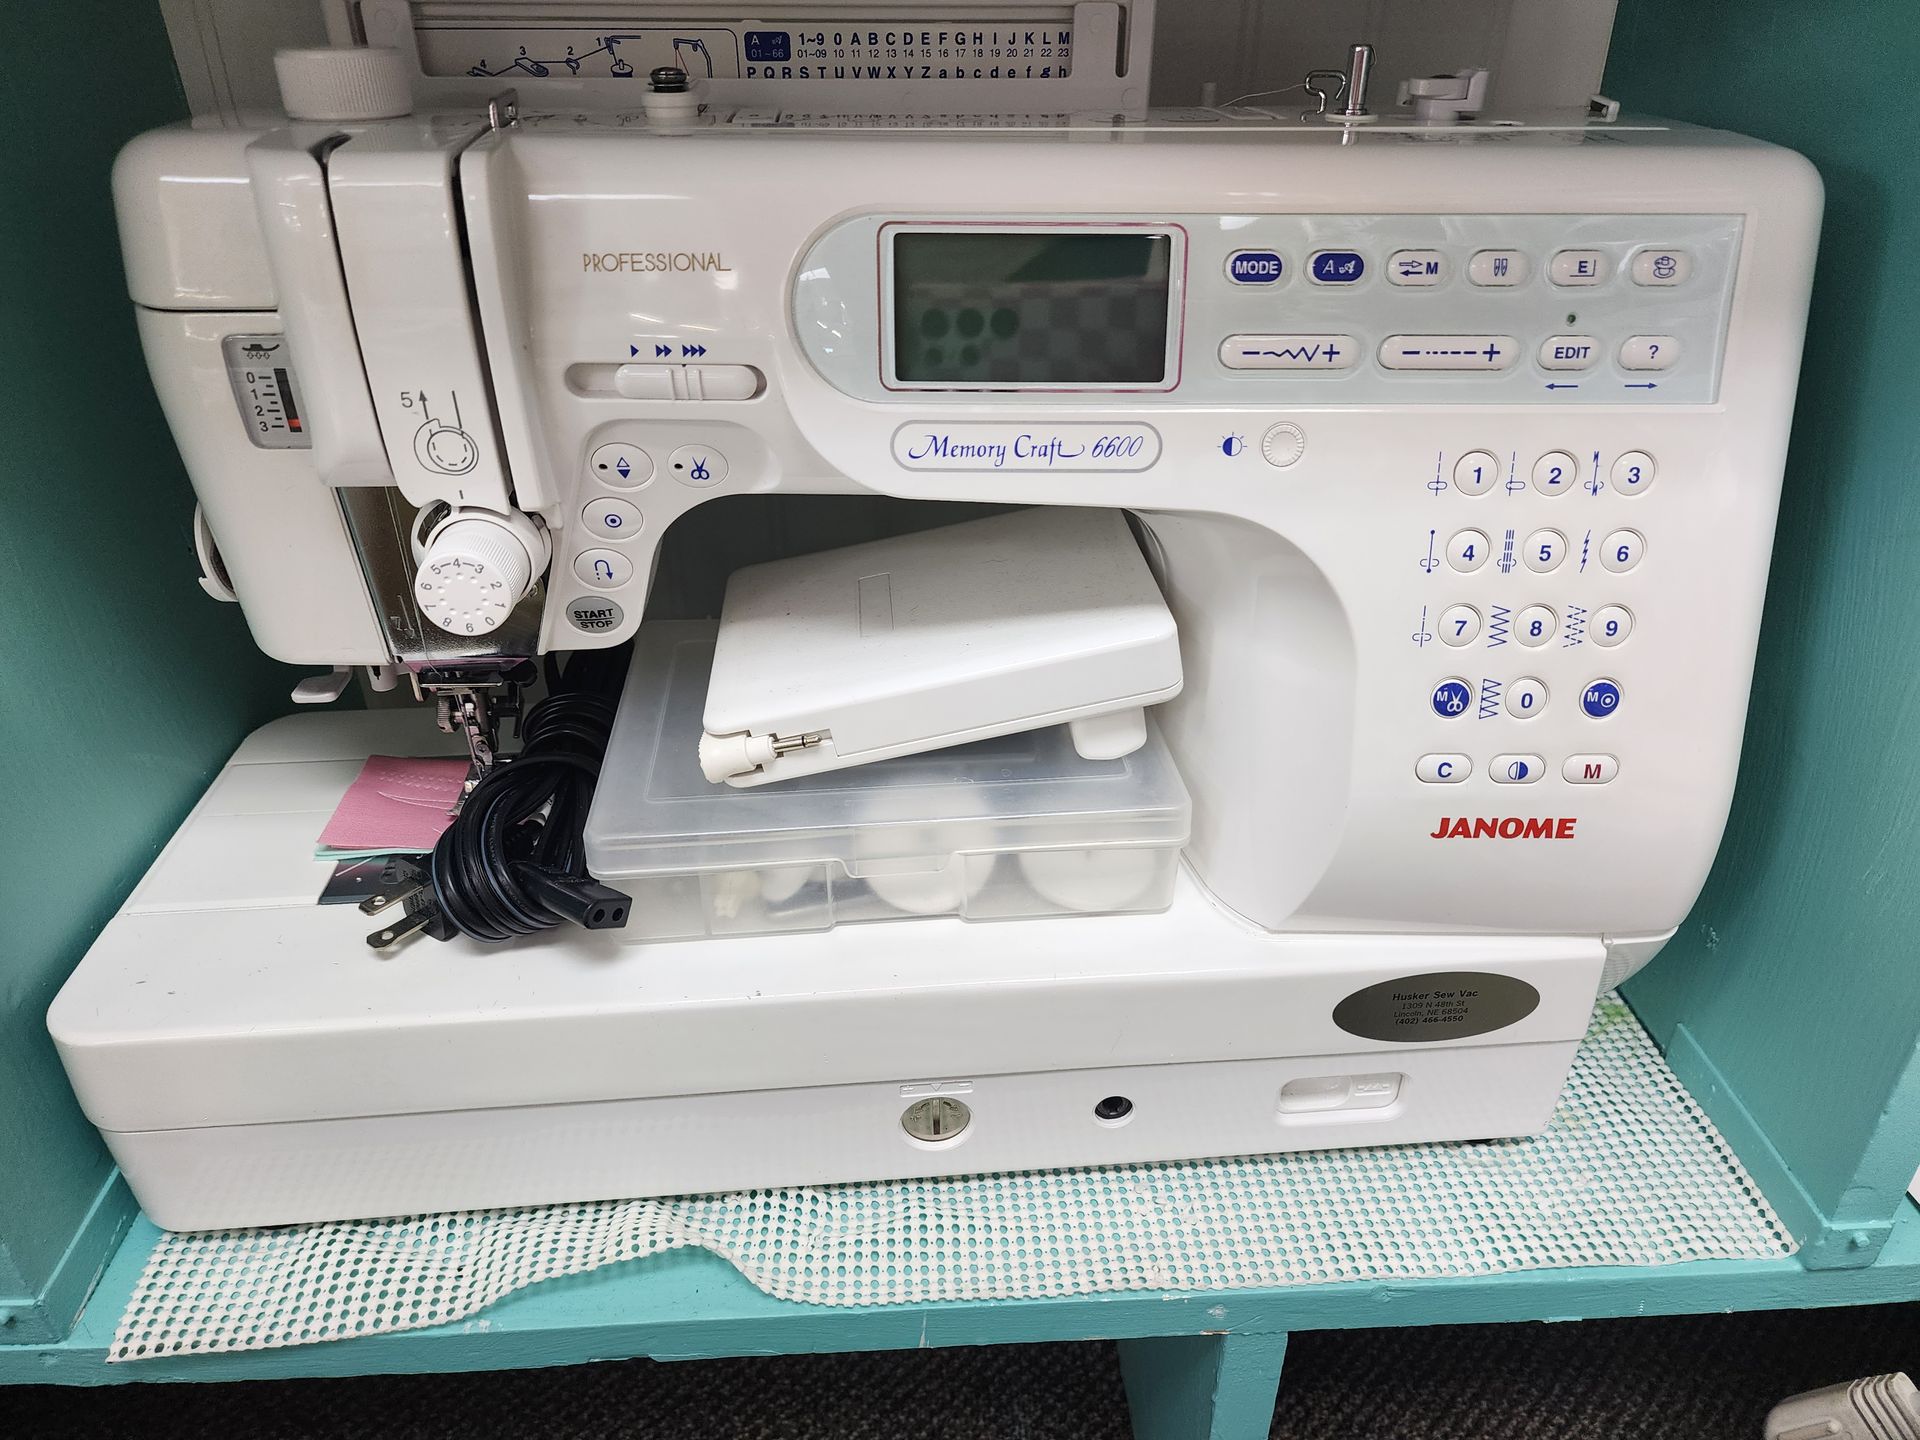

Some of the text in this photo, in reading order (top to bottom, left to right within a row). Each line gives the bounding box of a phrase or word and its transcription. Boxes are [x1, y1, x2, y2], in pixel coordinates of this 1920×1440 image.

[596, 38, 601, 47] 1
[751, 35, 759, 45] A
[798, 32, 825, 46] 1~9
[834, 32, 842, 46] 0
[851, 32, 861, 46] A
[869, 32, 879, 46] B
[886, 32, 895, 45] C
[903, 32, 914, 45] D
[921, 32, 930, 45] E
[939, 32, 947, 45] F
[955, 32, 966, 45] G
[973, 32, 982, 45] H
[1009, 32, 1016, 45] J
[1025, 32, 1034, 45] K
[1043, 32, 1051, 44] L
[1059, 32, 1070, 44] M
[520, 47, 526, 56] 3
[567, 47, 573, 56] 2
[798, 49, 1068, 58] 01~09 10 11 12 13 14 15 16 17 18 19 20 21 22 23
[480, 60, 487, 69] 4
[747, 66, 1066, 79] P Q R S T U V W X Y Z a b c d e f g h
[583, 252, 732, 272] PROFESSIONAL
[1235, 260, 1279, 275] MODE
[1322, 261, 1335, 274] A
[1426, 262, 1438, 274] M
[1578, 261, 1587, 273] E
[1554, 346, 1590, 360] EDIT
[1649, 345, 1659, 359] ?
[246, 372, 255, 383] 0
[251, 389, 258, 399] 1
[400, 392, 413, 408] 5
[255, 406, 264, 416] 2
[259, 421, 268, 432] 3
[908, 434, 1144, 468] Memory Craft 6600
[1473, 467, 1481, 483] 1
[1549, 467, 1562, 484] 2
[1627, 467, 1641, 483] 3
[1463, 545, 1474, 561] 4
[1539, 545, 1551, 561] 5
[1616, 545, 1629, 562] 6
[430, 563, 442, 575] 5
[453, 558, 461, 568] 4
[474, 564, 485, 574] 3
[574, 609, 614, 619] START
[443, 617, 452, 627] 8
[580, 620, 613, 628] STOP
[1455, 620, 1467, 636] 7
[1530, 620, 1542, 636] 8
[1605, 620, 1618, 636] 9
[1436, 691, 1448, 702] M
[1521, 693, 1533, 709] 0
[1587, 692, 1598, 702] M
[1437, 762, 1452, 778] C
[1584, 764, 1601, 779] M
[1430, 817, 1577, 839] JANOME
[1392, 990, 1478, 1001] Husker Sew Vac
[1402, 1002, 1424, 1010] 1309
[1435, 1000, 1453, 1008] 48th
[1427, 1008, 1439, 1016] NE
[1442, 1007, 1469, 1015] 68504
[1422, 1015, 1464, 1023] 466-4550
